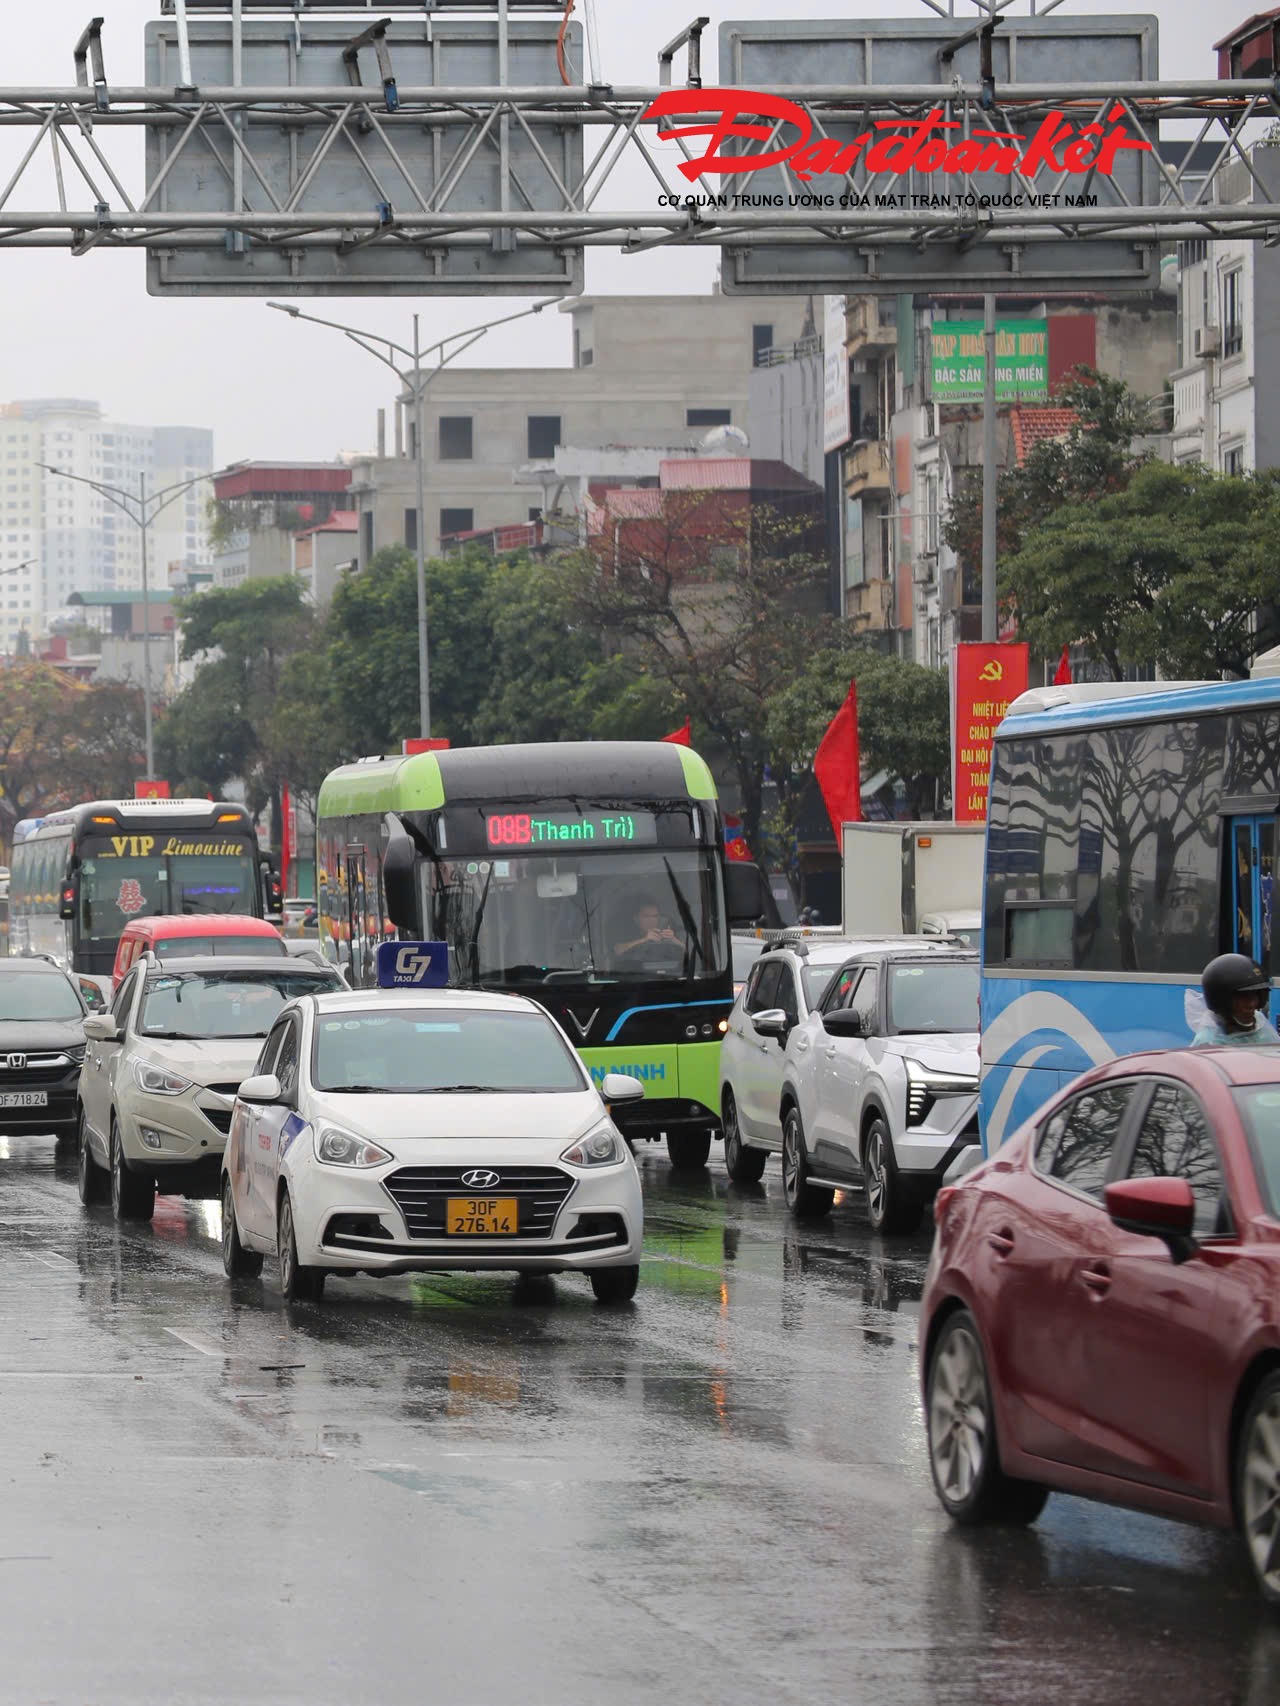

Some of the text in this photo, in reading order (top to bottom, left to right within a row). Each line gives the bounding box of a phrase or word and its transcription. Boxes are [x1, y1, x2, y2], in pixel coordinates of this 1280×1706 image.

[972, 701, 995, 719] NHIỆT
[969, 724, 990, 740] CHÀO
[961, 749, 974, 766] ĐẠI
[976, 747, 989, 766] HỘI
[488, 814, 532, 844] 08B
[112, 836, 244, 857] VIP Limousine
[395, 947, 432, 983] G7
[393, 975, 412, 983] TAXI
[467, 1201, 497, 1216] 30F
[455, 1217, 510, 1232] 276.14
